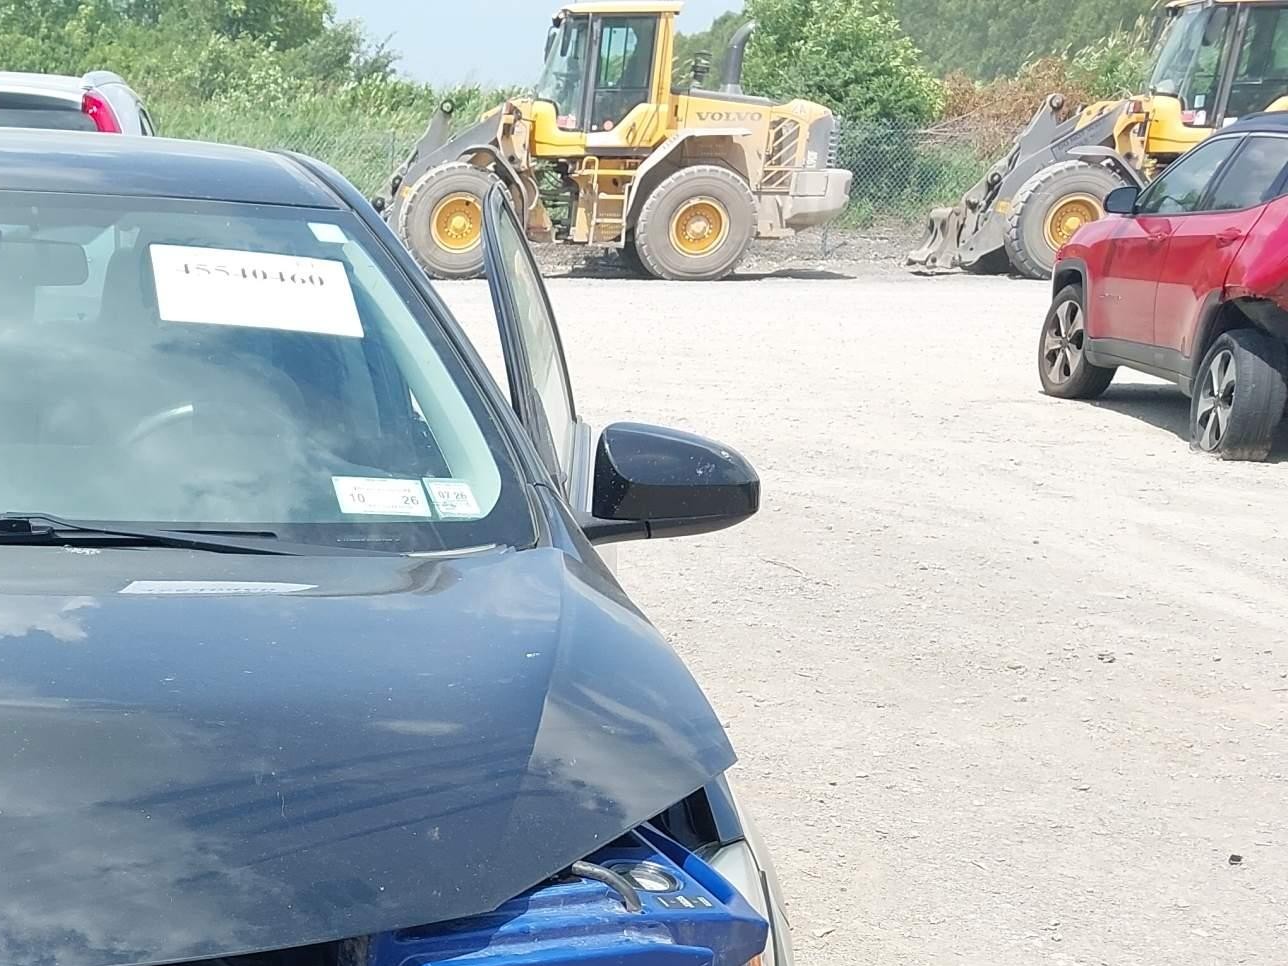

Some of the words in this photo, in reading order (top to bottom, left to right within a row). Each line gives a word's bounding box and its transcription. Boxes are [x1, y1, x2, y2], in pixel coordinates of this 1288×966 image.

[696, 111, 762, 122] VOLVO
[349, 493, 365, 503] 10
[402, 495, 419, 505] 26
